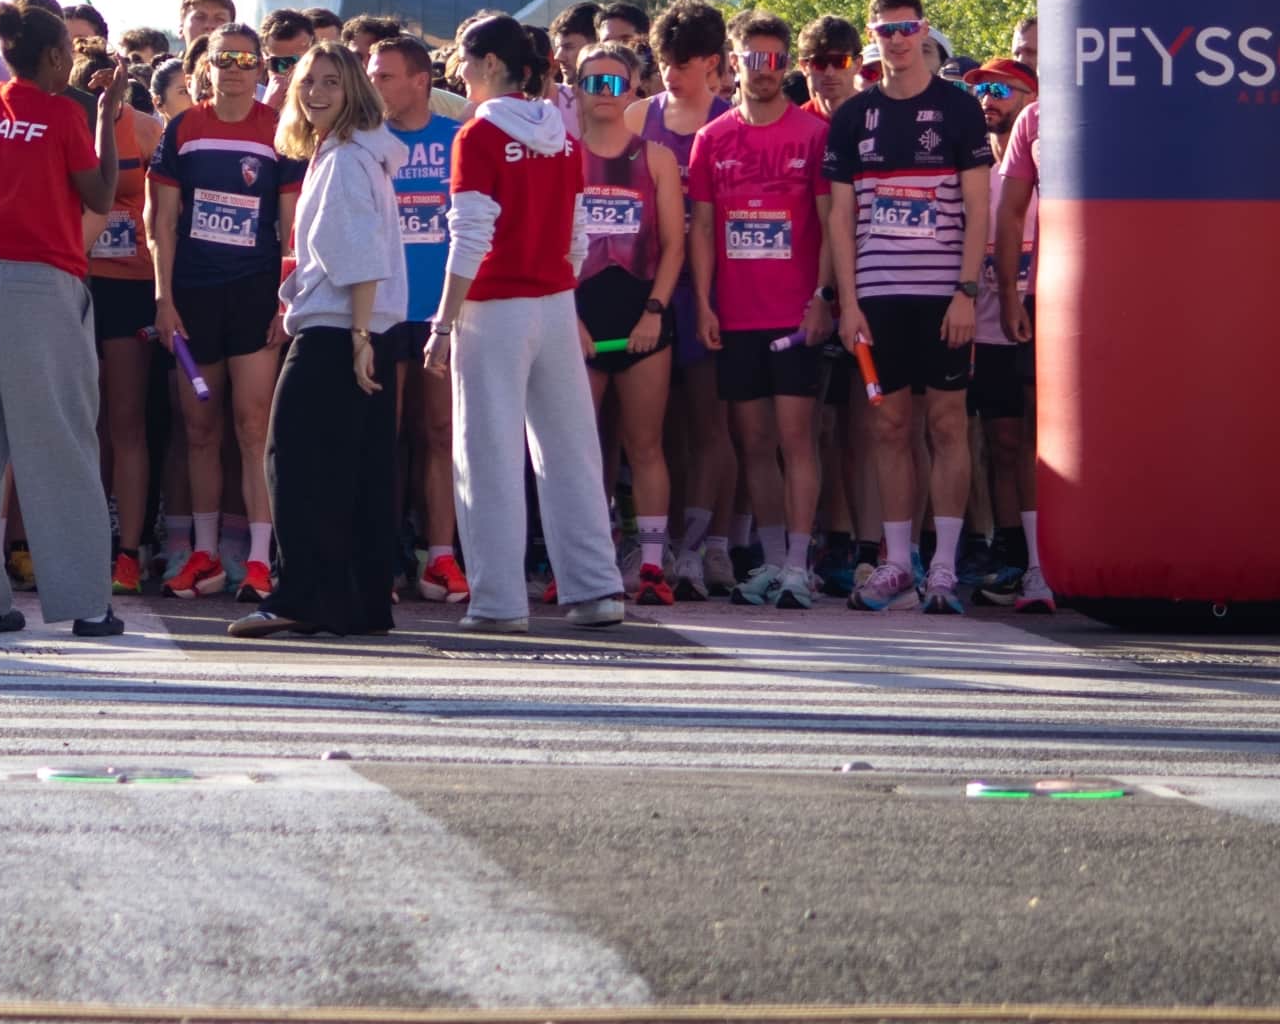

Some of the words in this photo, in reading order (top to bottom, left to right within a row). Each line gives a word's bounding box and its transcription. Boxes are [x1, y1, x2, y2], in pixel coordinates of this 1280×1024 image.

[1076, 26, 1280, 87] PEYSS
[400, 142, 445, 167] AC
[197, 211, 252, 235] 500-1
[874, 207, 931, 224] 467-1
[729, 231, 785, 247] 053-1
